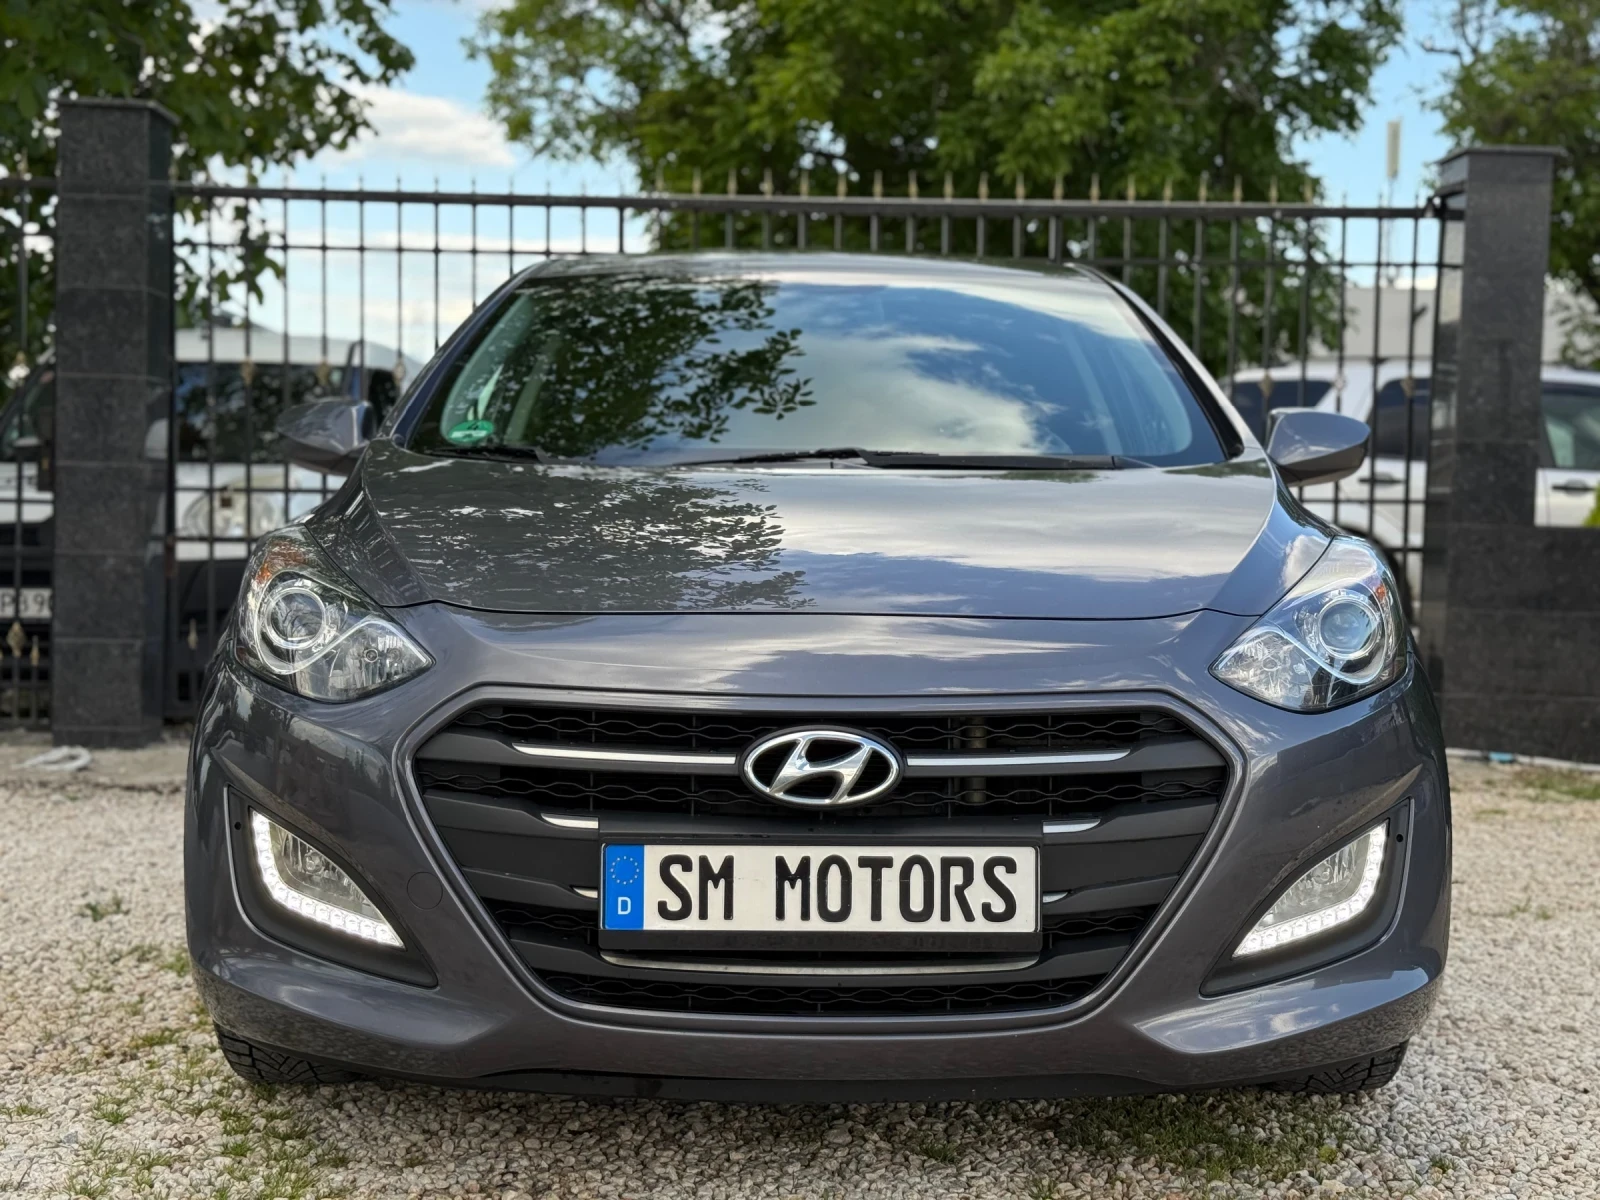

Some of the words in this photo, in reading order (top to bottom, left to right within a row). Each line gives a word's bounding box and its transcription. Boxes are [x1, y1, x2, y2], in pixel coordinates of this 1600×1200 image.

[616, 896, 632, 915] D
[657, 854, 735, 921] SM
[775, 854, 1017, 923] MOTORS
